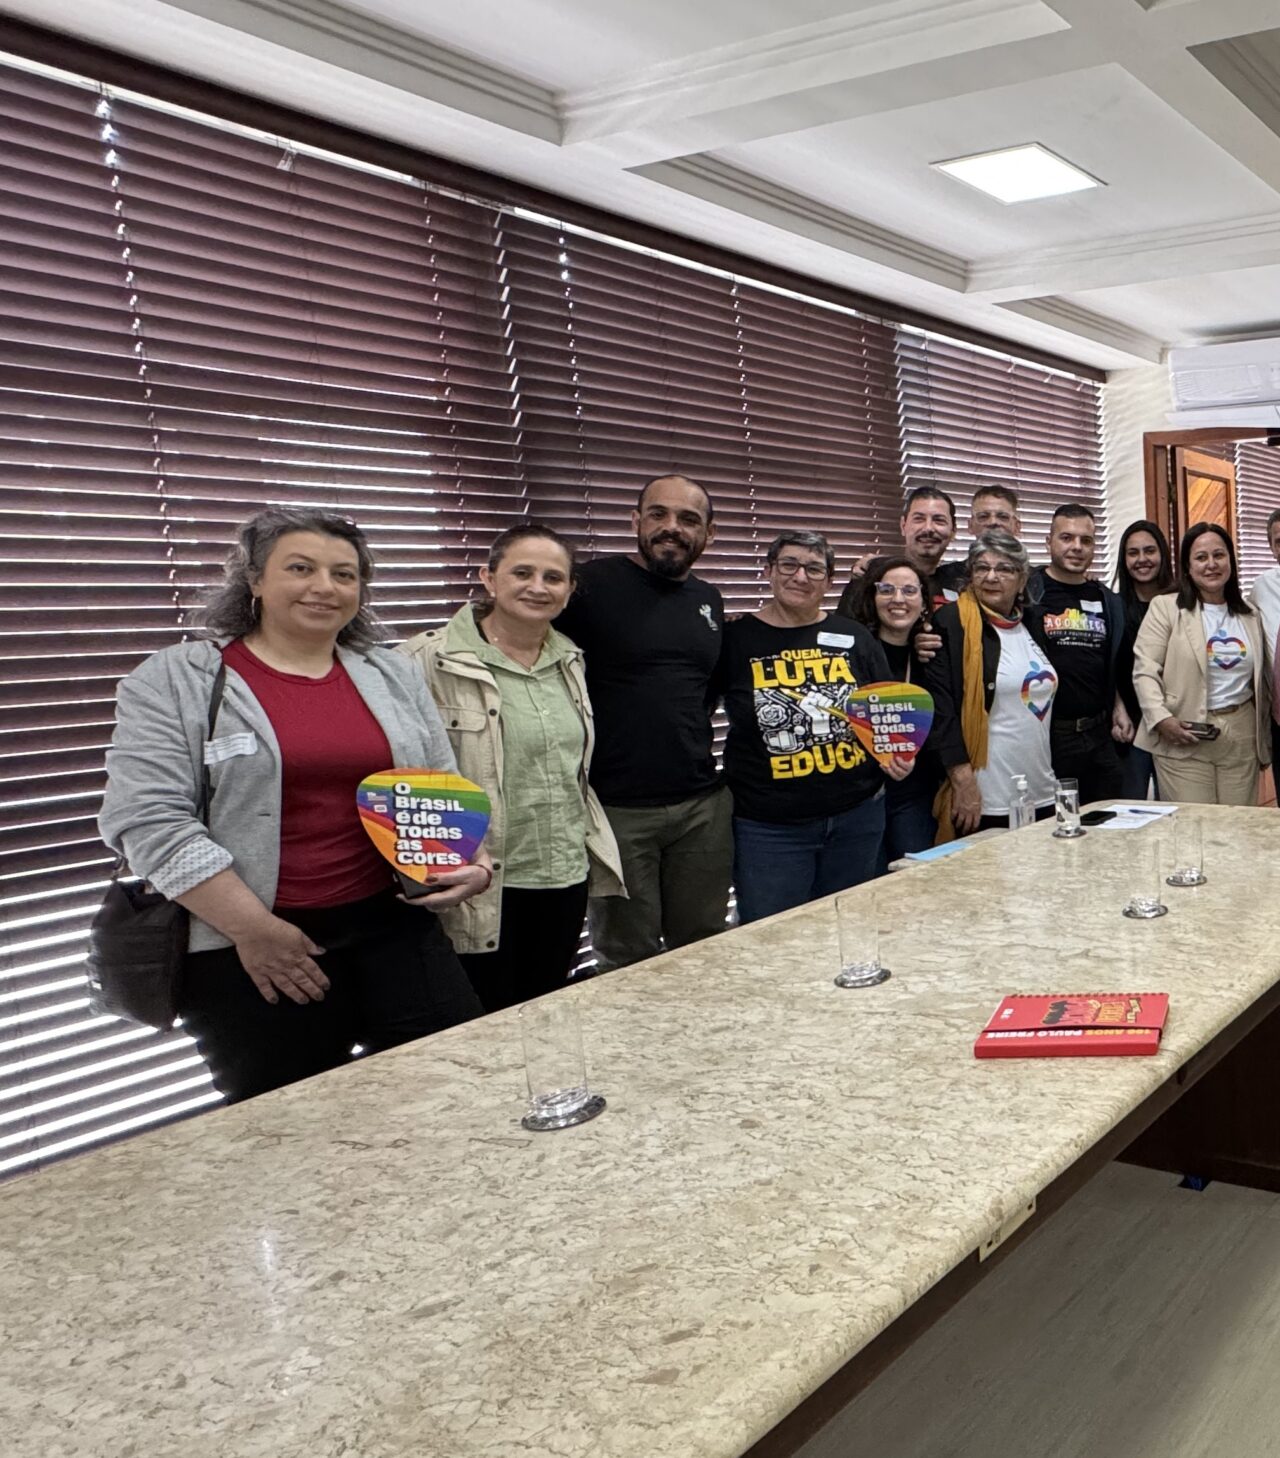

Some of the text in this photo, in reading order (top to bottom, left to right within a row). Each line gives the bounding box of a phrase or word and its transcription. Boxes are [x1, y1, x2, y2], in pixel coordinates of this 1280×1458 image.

[781, 649, 822, 660] QUEM
[751, 657, 856, 688] LUTA
[868, 693, 880, 703] O
[882, 713, 901, 724] de
[873, 734, 890, 743] as
[770, 742, 866, 779] EDUCA
[394, 782, 411, 795] O
[395, 809, 442, 826] é de
[396, 839, 423, 851] as
[985, 1031, 1035, 1039] FREIRE
[1036, 1029, 1083, 1037] PAULO
